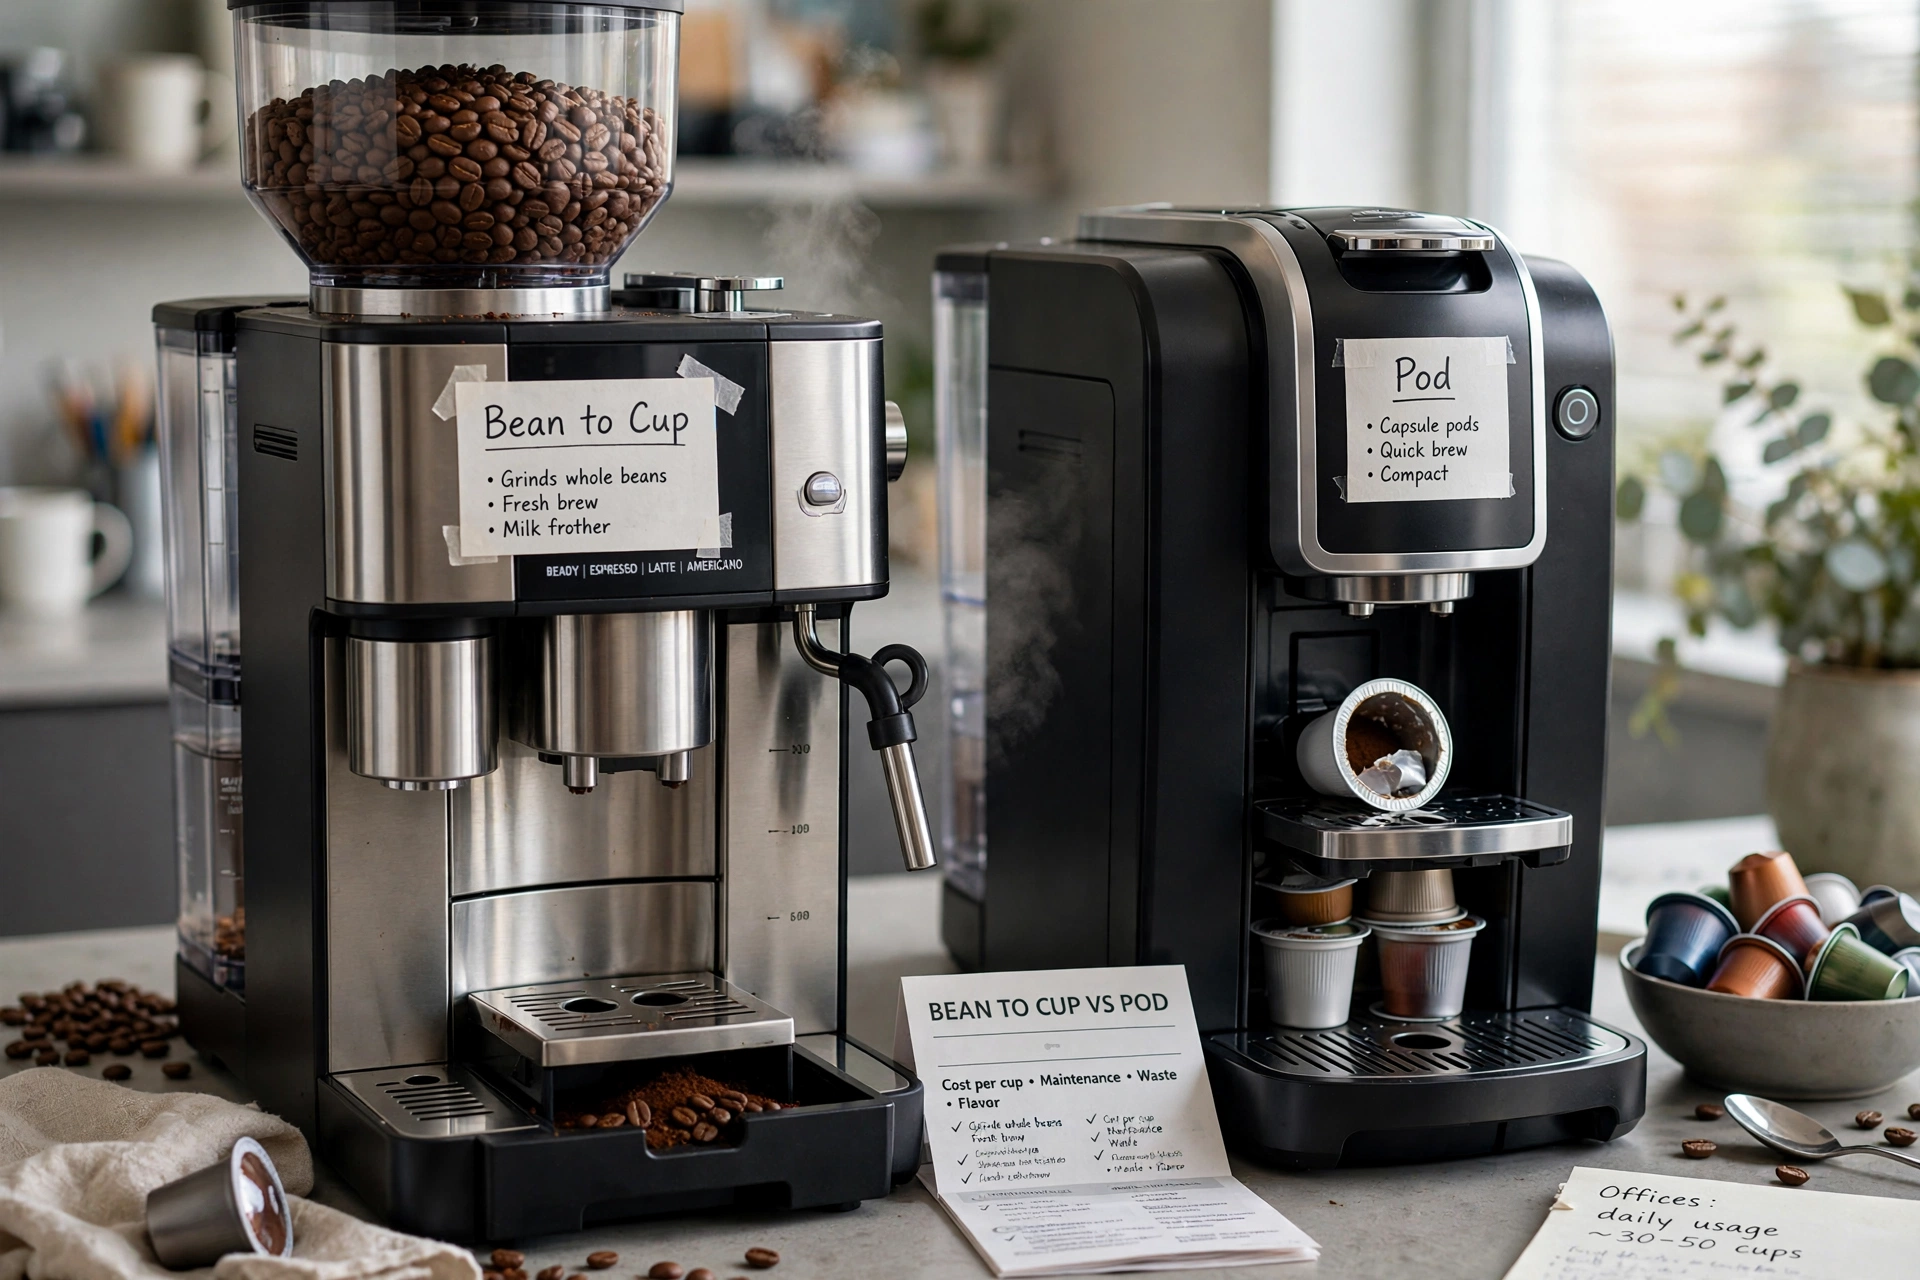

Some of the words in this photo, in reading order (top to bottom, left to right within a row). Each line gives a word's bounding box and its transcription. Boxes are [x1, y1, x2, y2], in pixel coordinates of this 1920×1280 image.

[1395, 356, 1451, 392] Pod
[485, 404, 565, 439] Bean
[580, 404, 613, 435] to
[630, 401, 689, 445] Cup
[1380, 416, 1439, 437] Capsule
[1446, 415, 1479, 438] pods
[1380, 441, 1425, 458] Quick
[1433, 441, 1467, 457] brew
[501, 469, 557, 488] Grinds
[566, 466, 613, 485] whole
[621, 467, 667, 483] beans
[1381, 465, 1448, 487] Compact
[503, 494, 549, 512] Fresh
[558, 494, 598, 510] brew
[503, 519, 541, 538] Milk
[548, 519, 610, 536] frother
[648, 562, 676, 573] LATTE
[929, 1000, 992, 1022] BEAN
[997, 999, 1029, 1017] TO
[1036, 996, 1081, 1016] CUP
[1085, 995, 1115, 1014] VS
[1121, 993, 1169, 1012] POD
[942, 1078, 971, 1092] Cost
[975, 1080, 996, 1091] per
[1000, 1078, 1023, 1091] cup
[1040, 1072, 1121, 1087] Maintenance
[1137, 1069, 1177, 1082] Waste
[959, 1097, 1000, 1109] Flavor
[1598, 1207, 1673, 1231] daily
[1694, 1217, 1779, 1240] usage
[1735, 1243, 1802, 1261] cups
